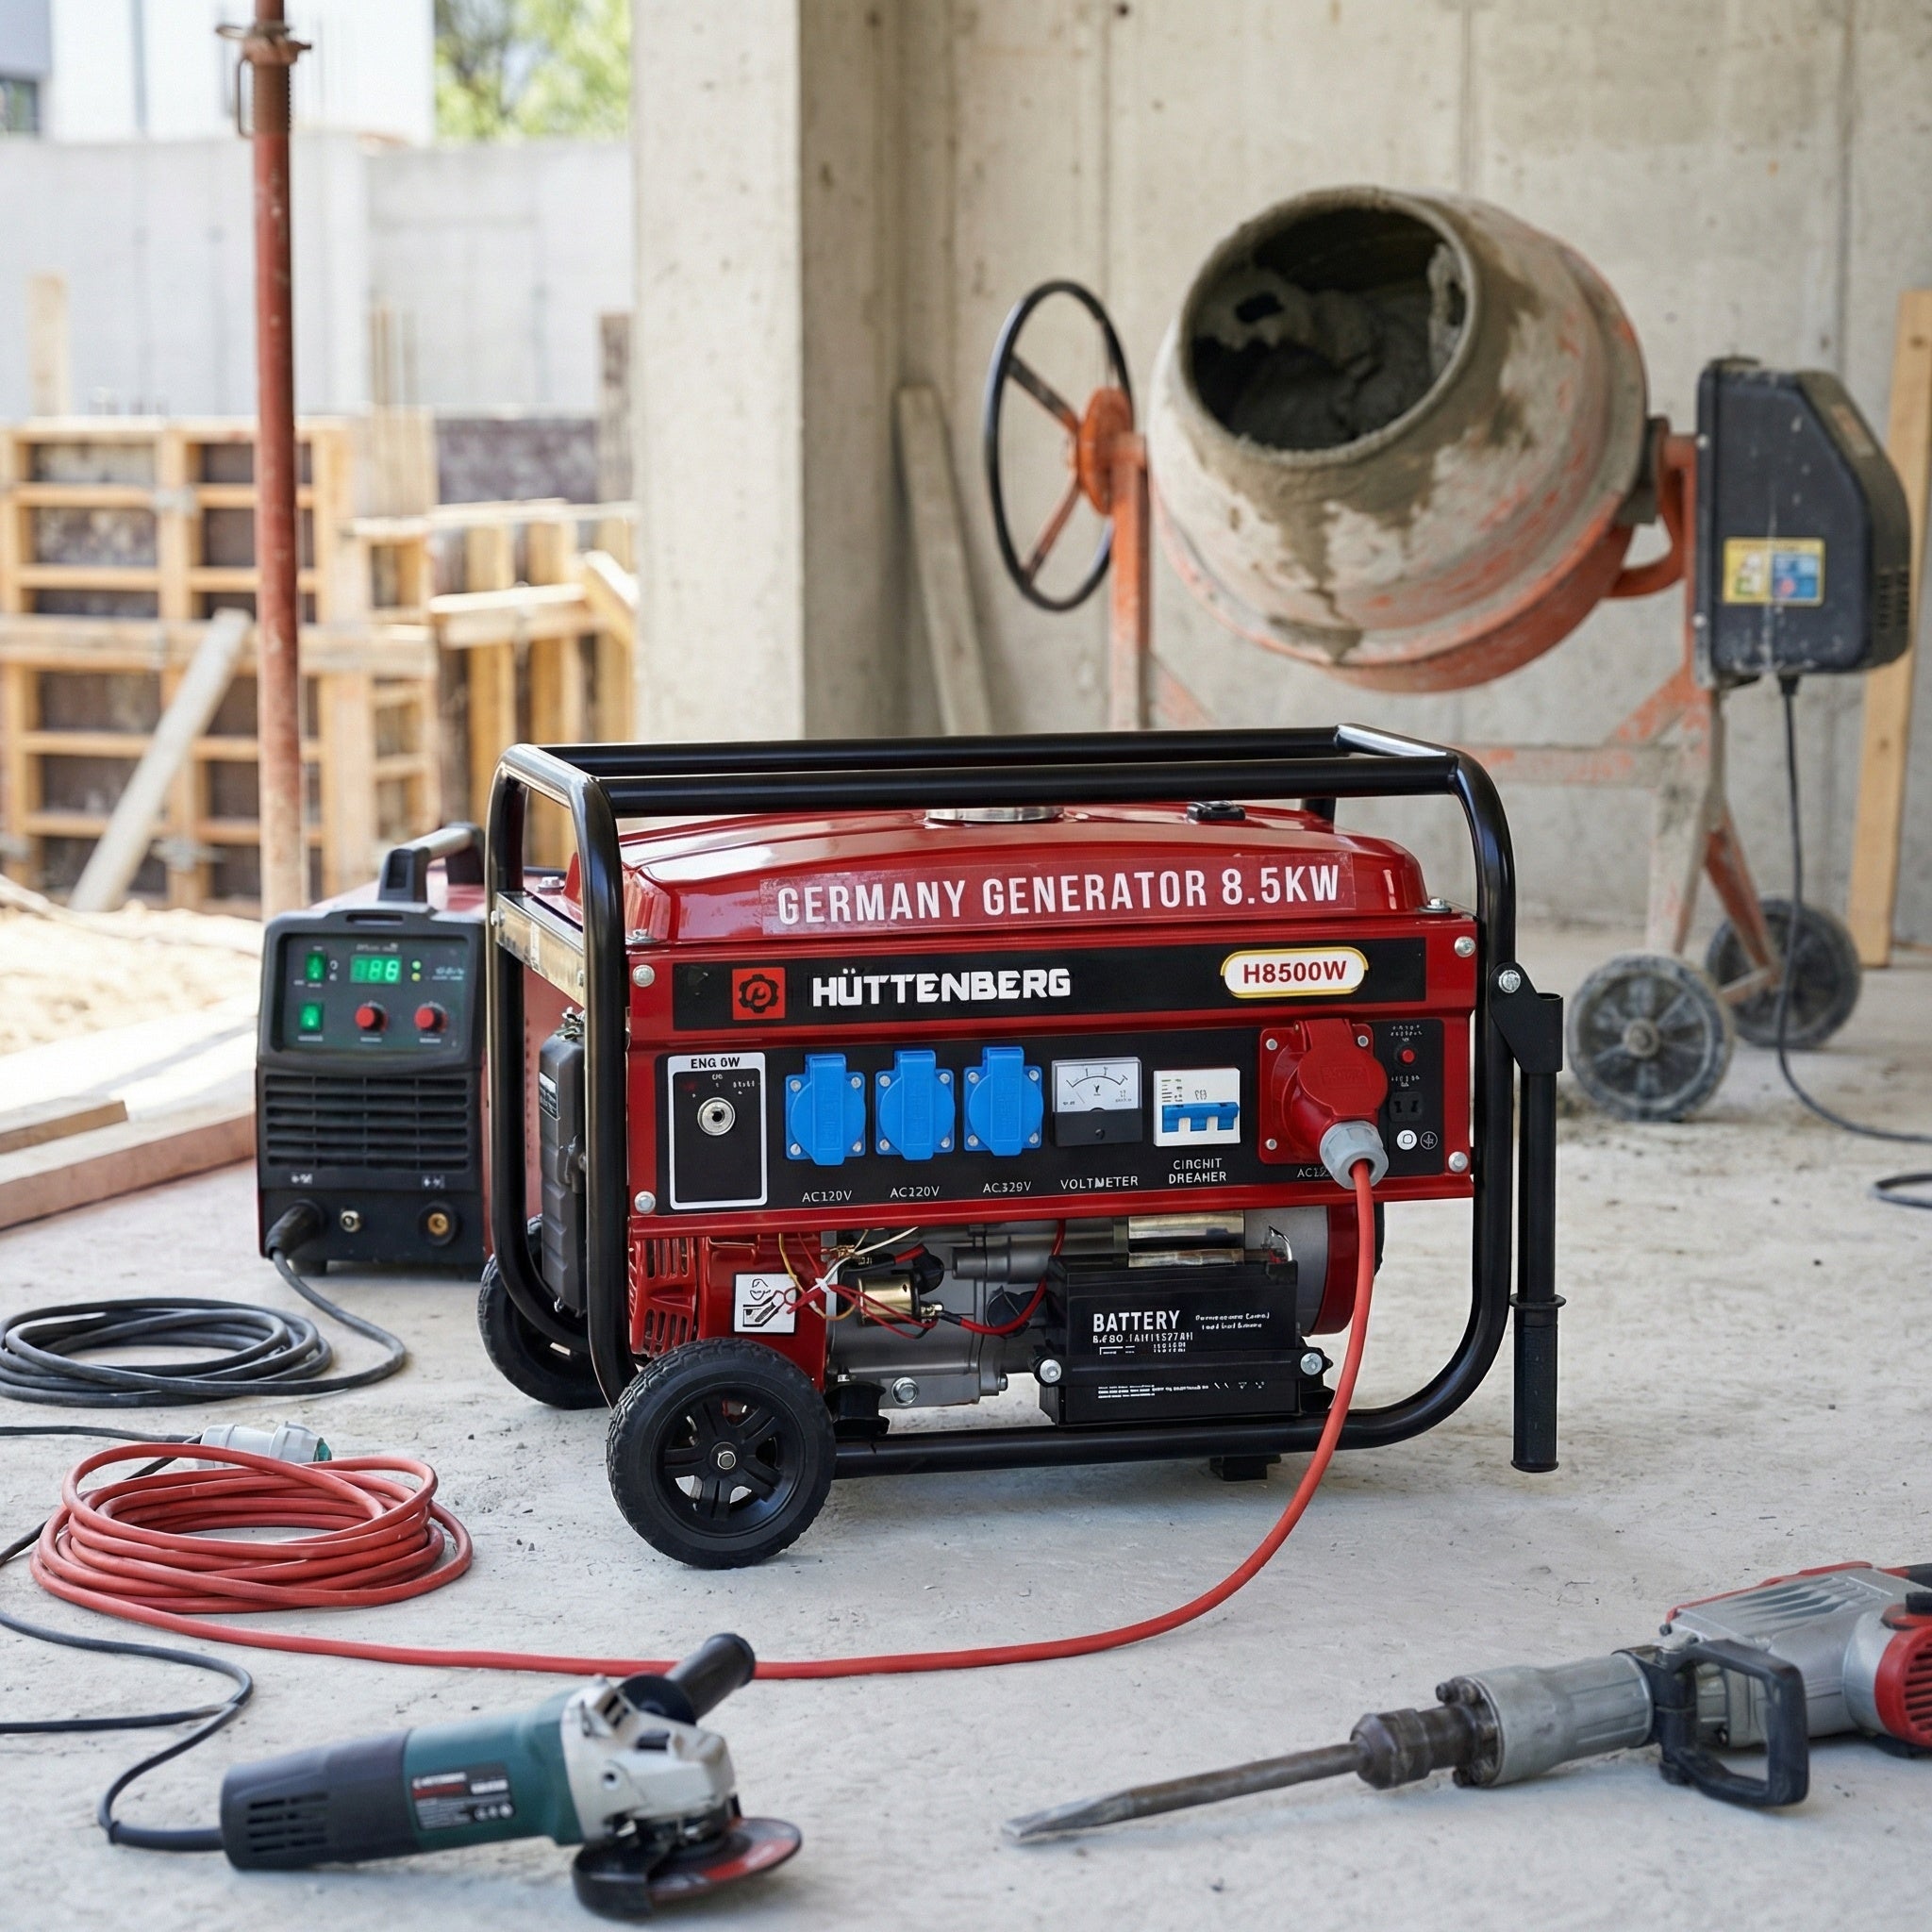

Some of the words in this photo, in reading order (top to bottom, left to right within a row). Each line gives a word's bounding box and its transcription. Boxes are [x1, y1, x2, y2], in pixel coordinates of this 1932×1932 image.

[777, 880, 965, 925] GERMANY
[982, 870, 1207, 916] GENERATOR
[1222, 865, 1339, 905] 8.5KW
[1243, 960, 1347, 984] H8500W
[812, 967, 1071, 1007] HÜTTENBERG
[691, 1058, 716, 1069] ENG
[1060, 1175, 1139, 1190] VOLTMETER
[802, 1190, 852, 1202] AC120V
[1093, 1310, 1180, 1332] BATTERY
